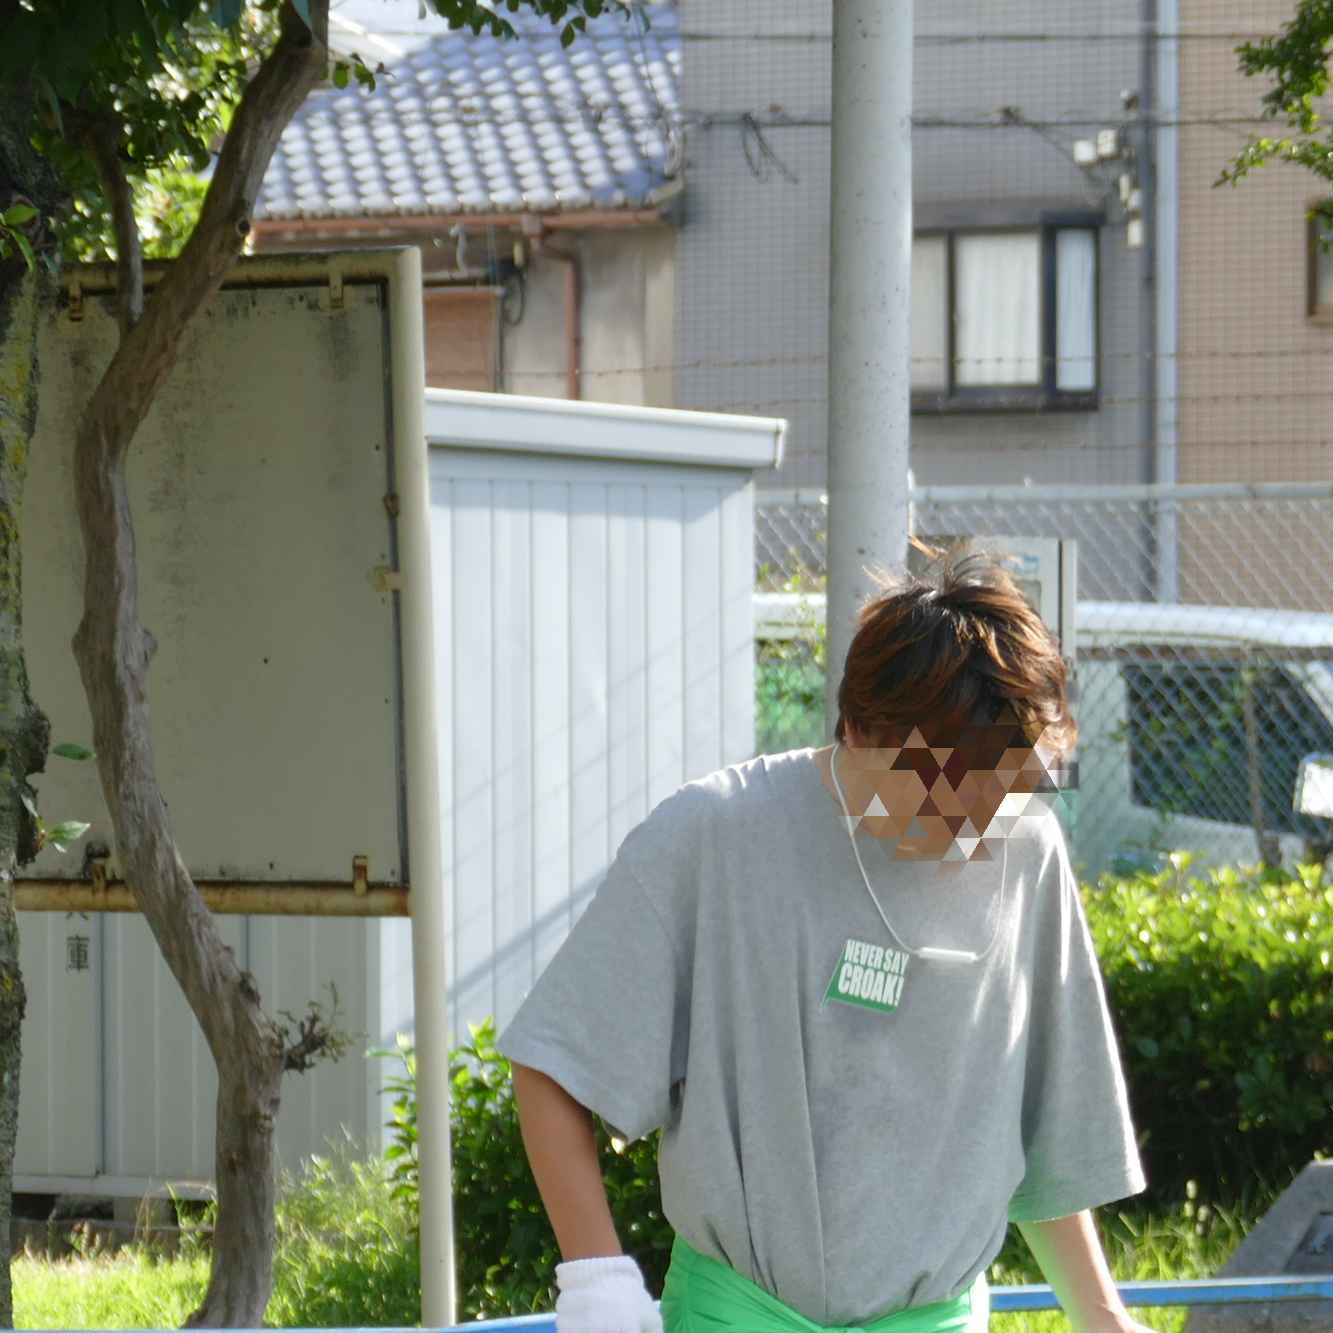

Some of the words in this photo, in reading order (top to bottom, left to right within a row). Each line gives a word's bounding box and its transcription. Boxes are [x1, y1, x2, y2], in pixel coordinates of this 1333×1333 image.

[844, 938, 885, 969] NEVER
[882, 948, 910, 976] SAY
[838, 962, 905, 1007] CROAK!
